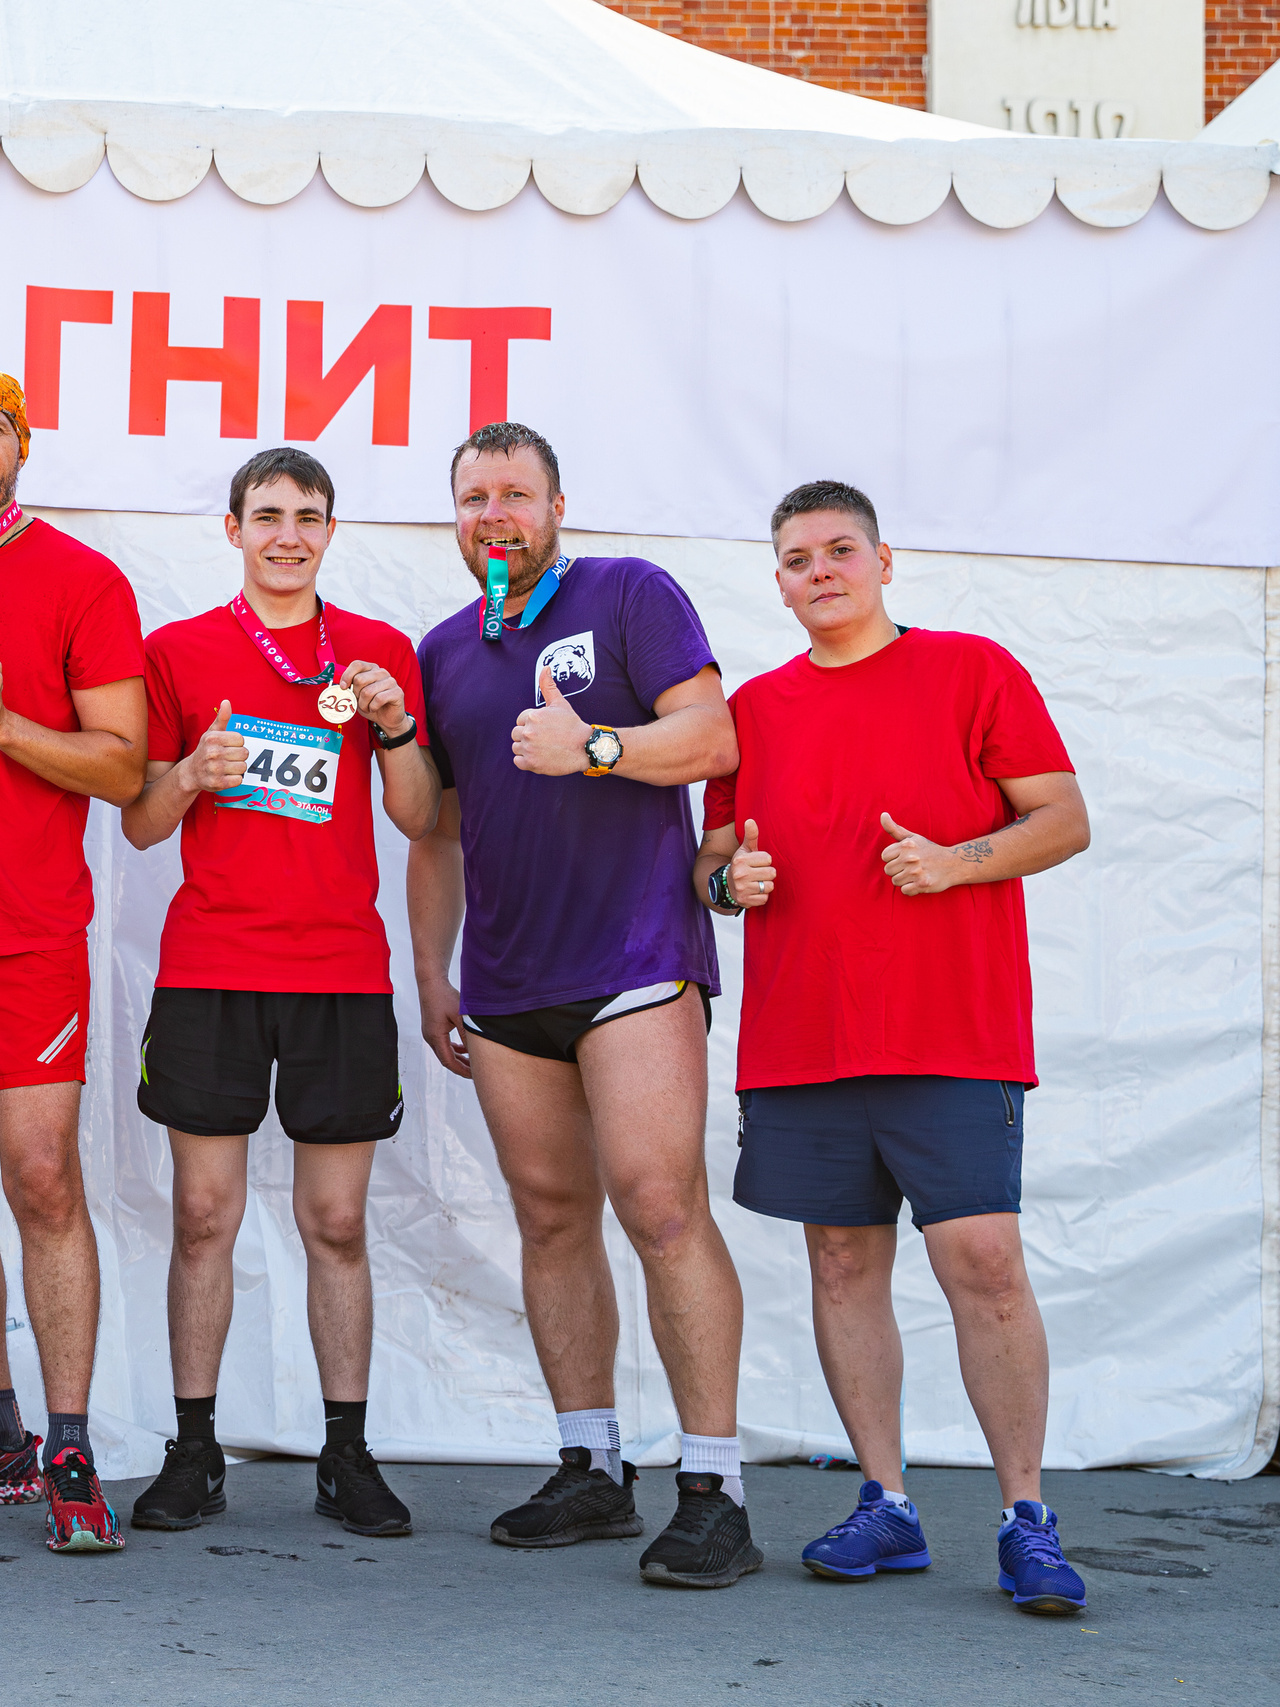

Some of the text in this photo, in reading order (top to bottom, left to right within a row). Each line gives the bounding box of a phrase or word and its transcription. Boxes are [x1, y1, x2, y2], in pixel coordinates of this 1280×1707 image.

[321, 695, 352, 712] 26
[235, 722, 323, 743] ПОЛУМАРАФОН
[242, 749, 327, 793] 466
[247, 786, 291, 811] 26
[296, 801, 328, 815] ЭТАЛОН
